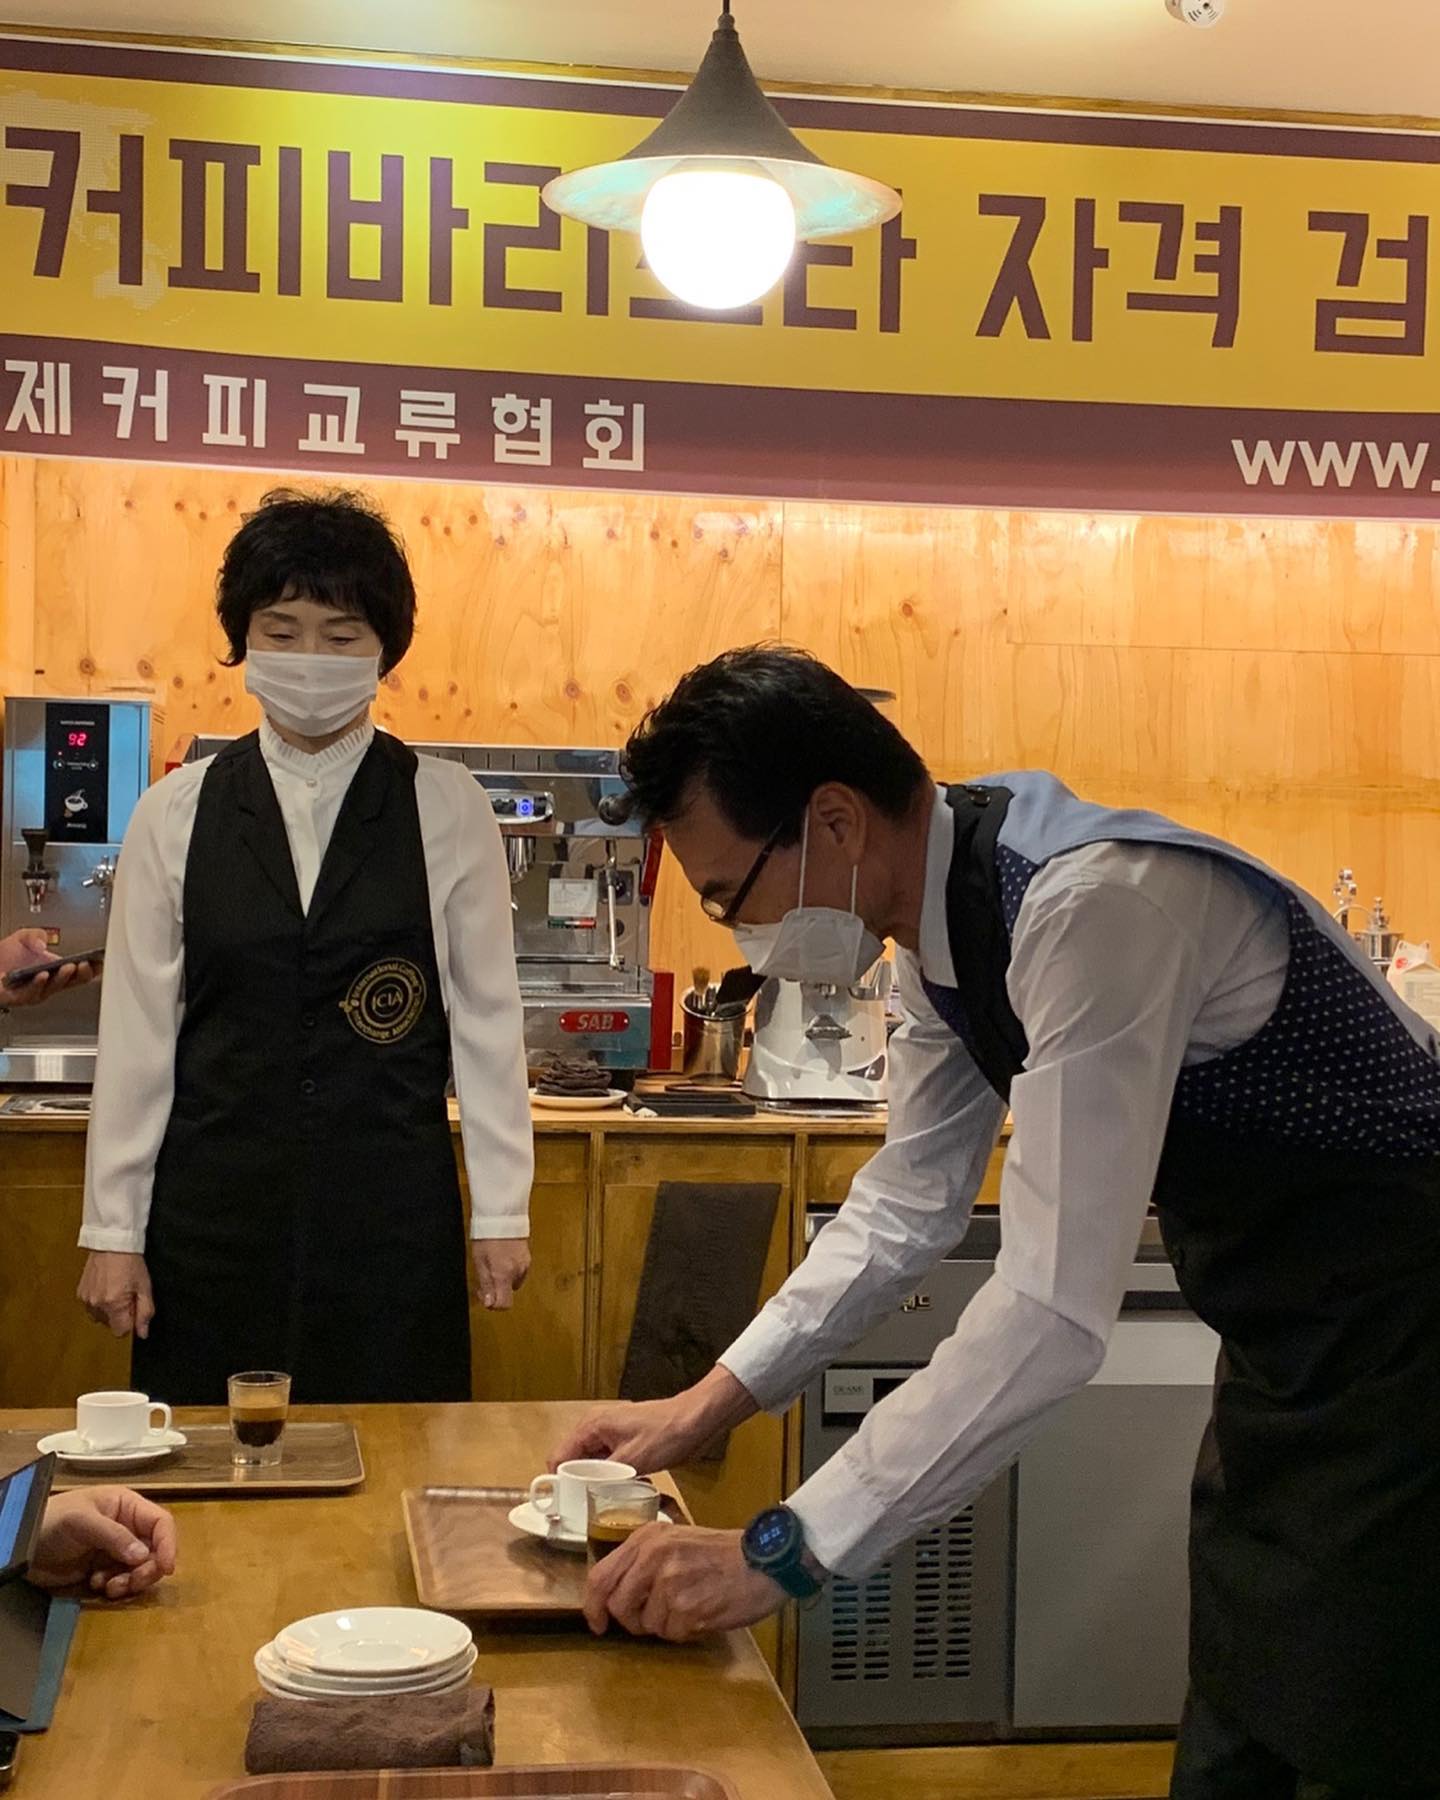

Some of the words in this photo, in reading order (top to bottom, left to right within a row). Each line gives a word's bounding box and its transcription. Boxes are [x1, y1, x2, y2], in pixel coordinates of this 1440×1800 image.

[975, 193, 1242, 348] 자격
[1307, 210, 1430, 357] 검
[68, 732, 88, 747] 92
[577, 1013, 614, 1030] SAB
